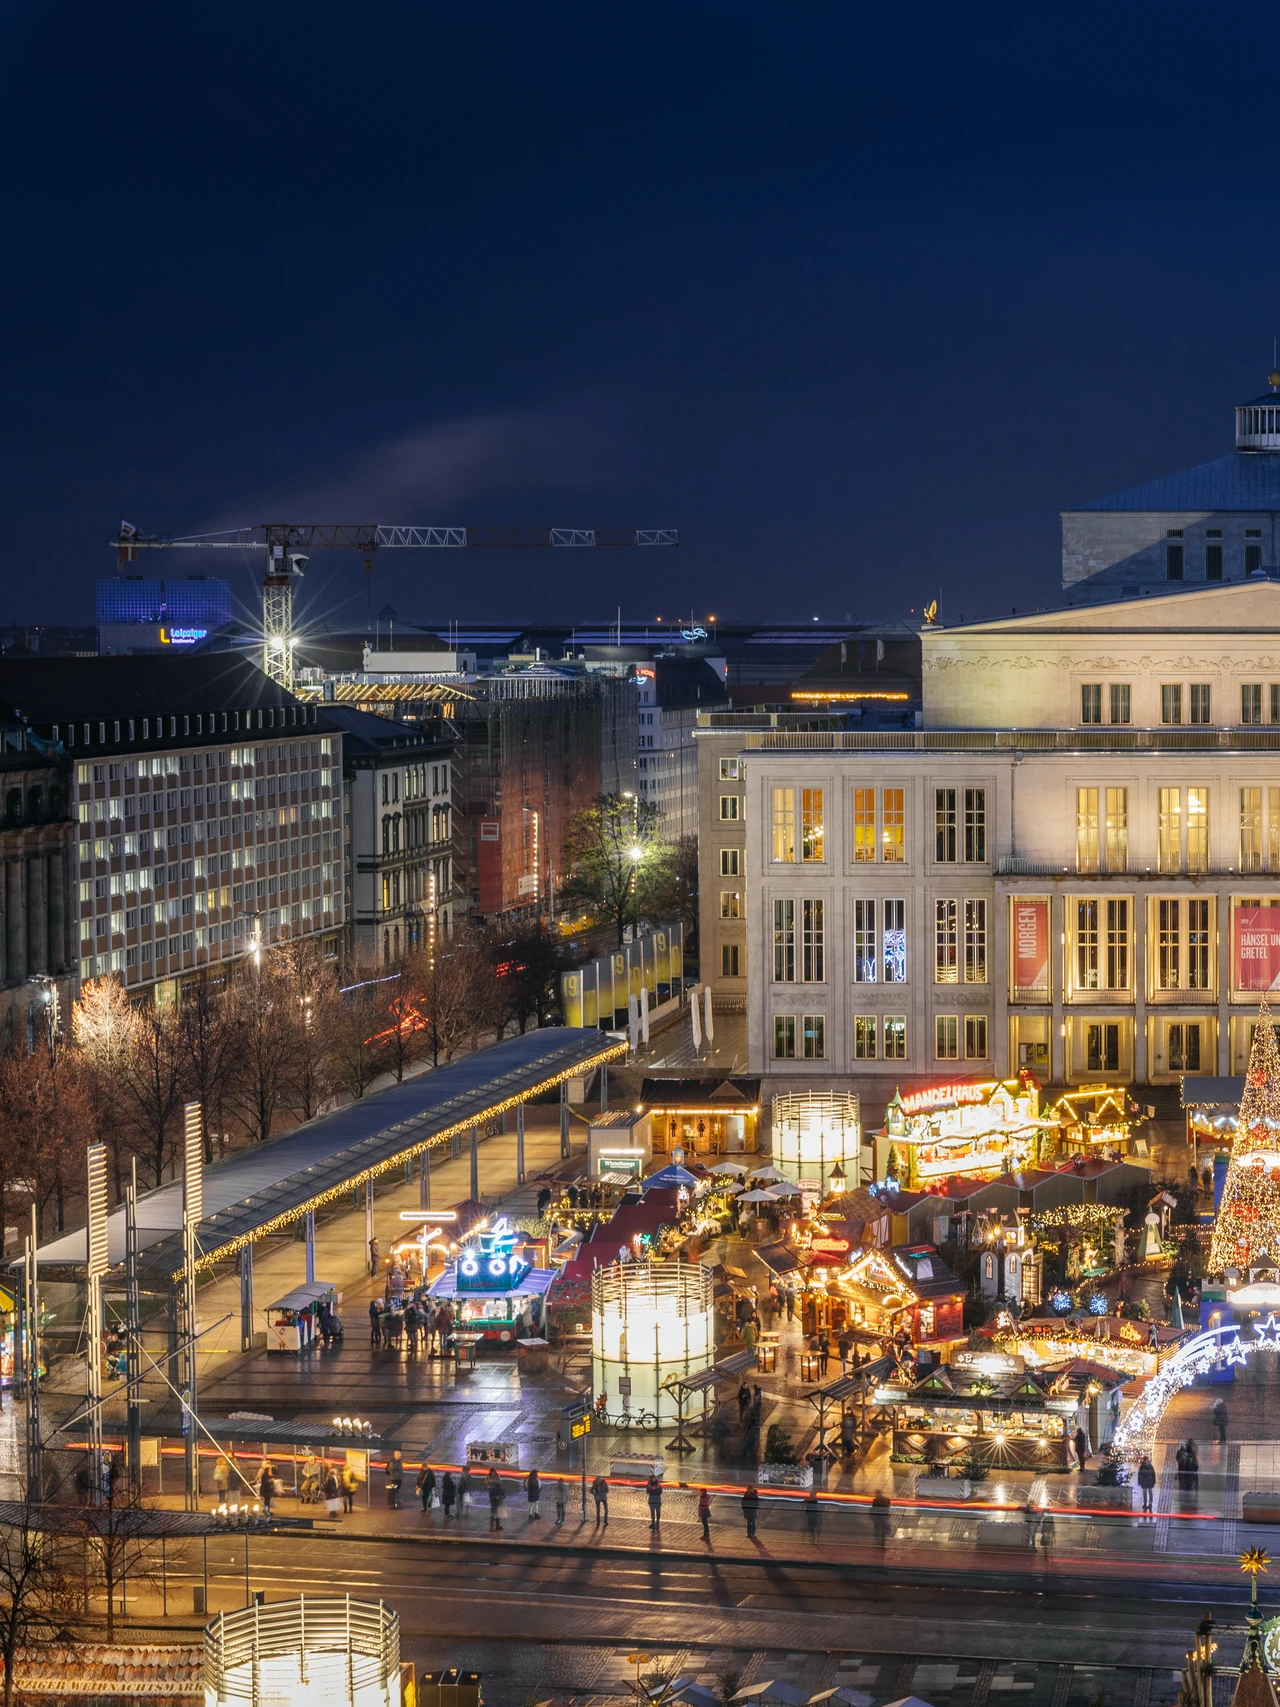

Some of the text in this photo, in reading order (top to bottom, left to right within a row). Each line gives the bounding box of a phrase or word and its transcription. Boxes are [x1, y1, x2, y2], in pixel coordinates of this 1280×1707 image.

[170, 628, 207, 639] Leipziger
[1018, 907, 1037, 959] MORGEN
[1240, 932, 1270, 947] HÄNSEL
[1240, 946, 1268, 960] GRETEL
[562, 975, 578, 997] 19
[902, 1085, 984, 1114] MANDELHAUS
[604, 1160, 636, 1168] Winterlounge
[14, 1679, 66, 1690] PZIGER
